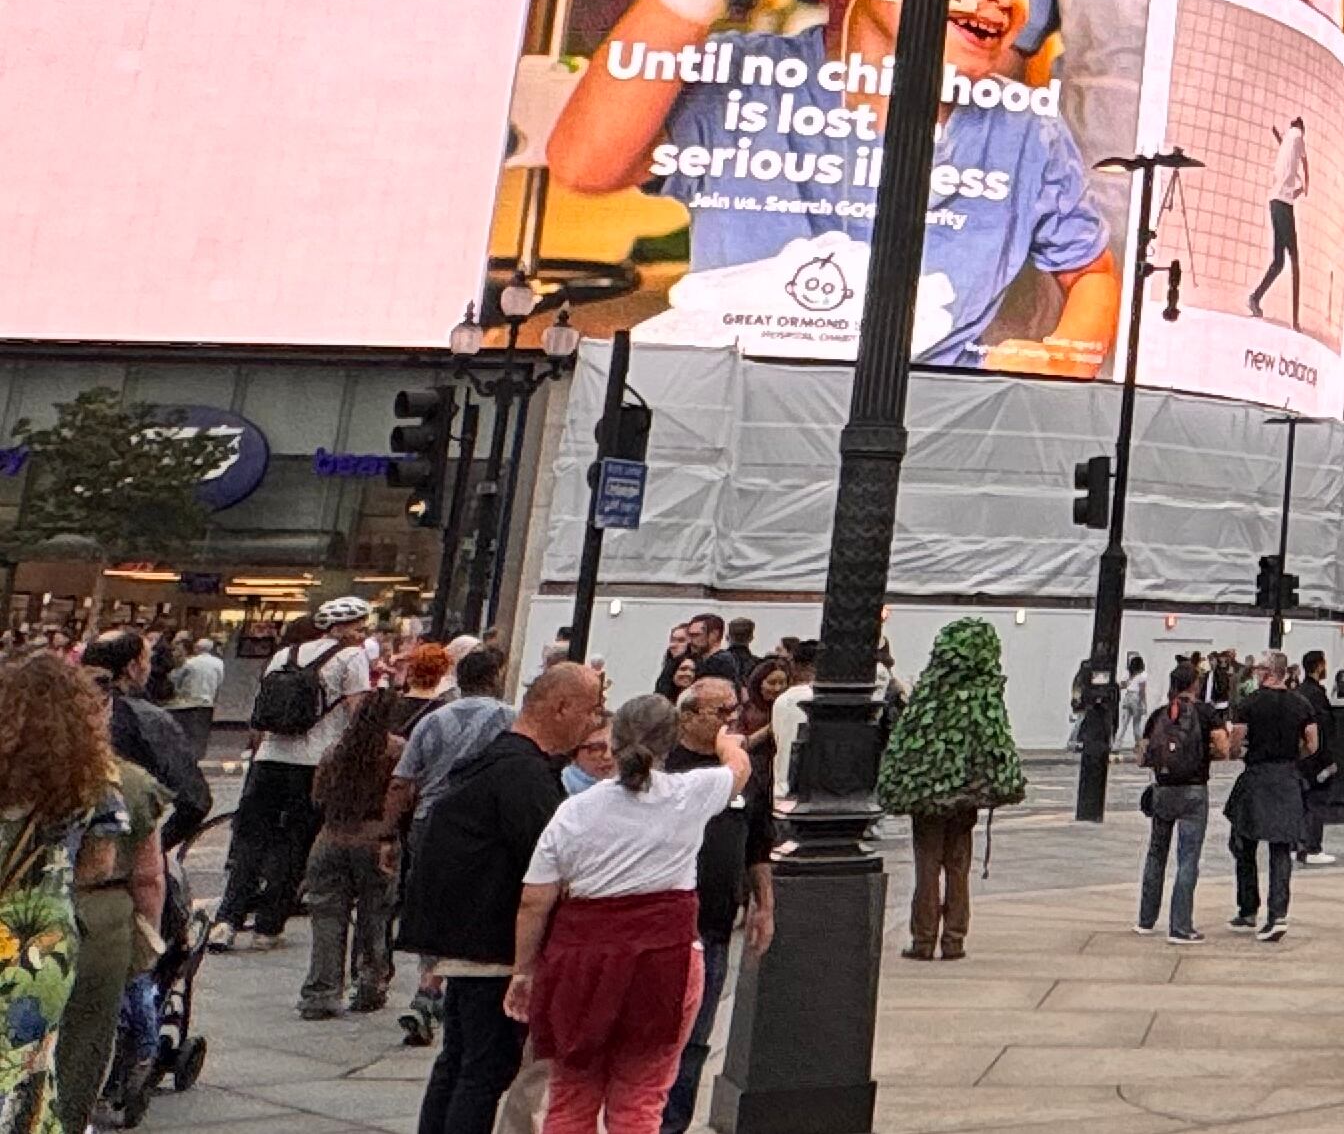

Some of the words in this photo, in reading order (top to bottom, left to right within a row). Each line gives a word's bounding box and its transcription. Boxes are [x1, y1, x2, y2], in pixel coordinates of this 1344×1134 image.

[607, 40, 733, 84] Until
[741, 53, 808, 88] no
[817, 52, 1061, 118] chihood
[724, 89, 769, 133] is
[777, 93, 877, 142] lost
[648, 137, 845, 186] serious
[852, 146, 1010, 202] iless
[688, 192, 731, 209] Join
[763, 196, 833, 215] Search
[722, 313, 773, 327] GREAT
[776, 316, 850, 332] ORMOND
[1244, 348, 1276, 374] new
